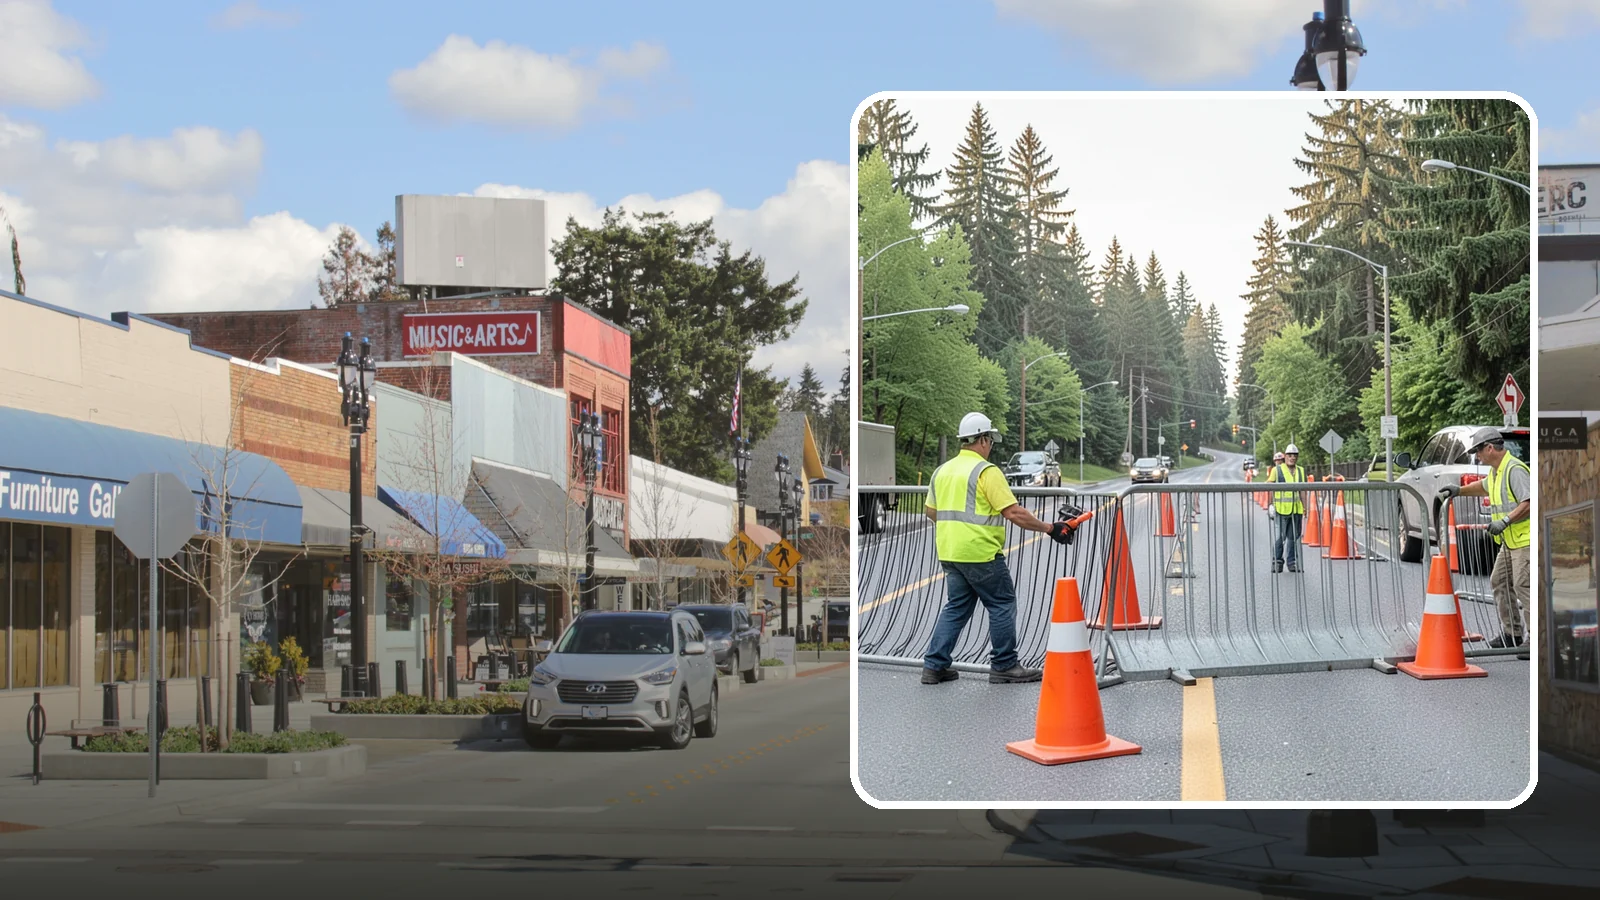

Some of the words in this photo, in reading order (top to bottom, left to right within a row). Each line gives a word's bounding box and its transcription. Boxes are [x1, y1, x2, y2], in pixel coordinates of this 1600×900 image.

[0, 471, 79, 515] Furniture
[89, 482, 122, 519] Gal
[454, 563, 479, 574] SUSHI
